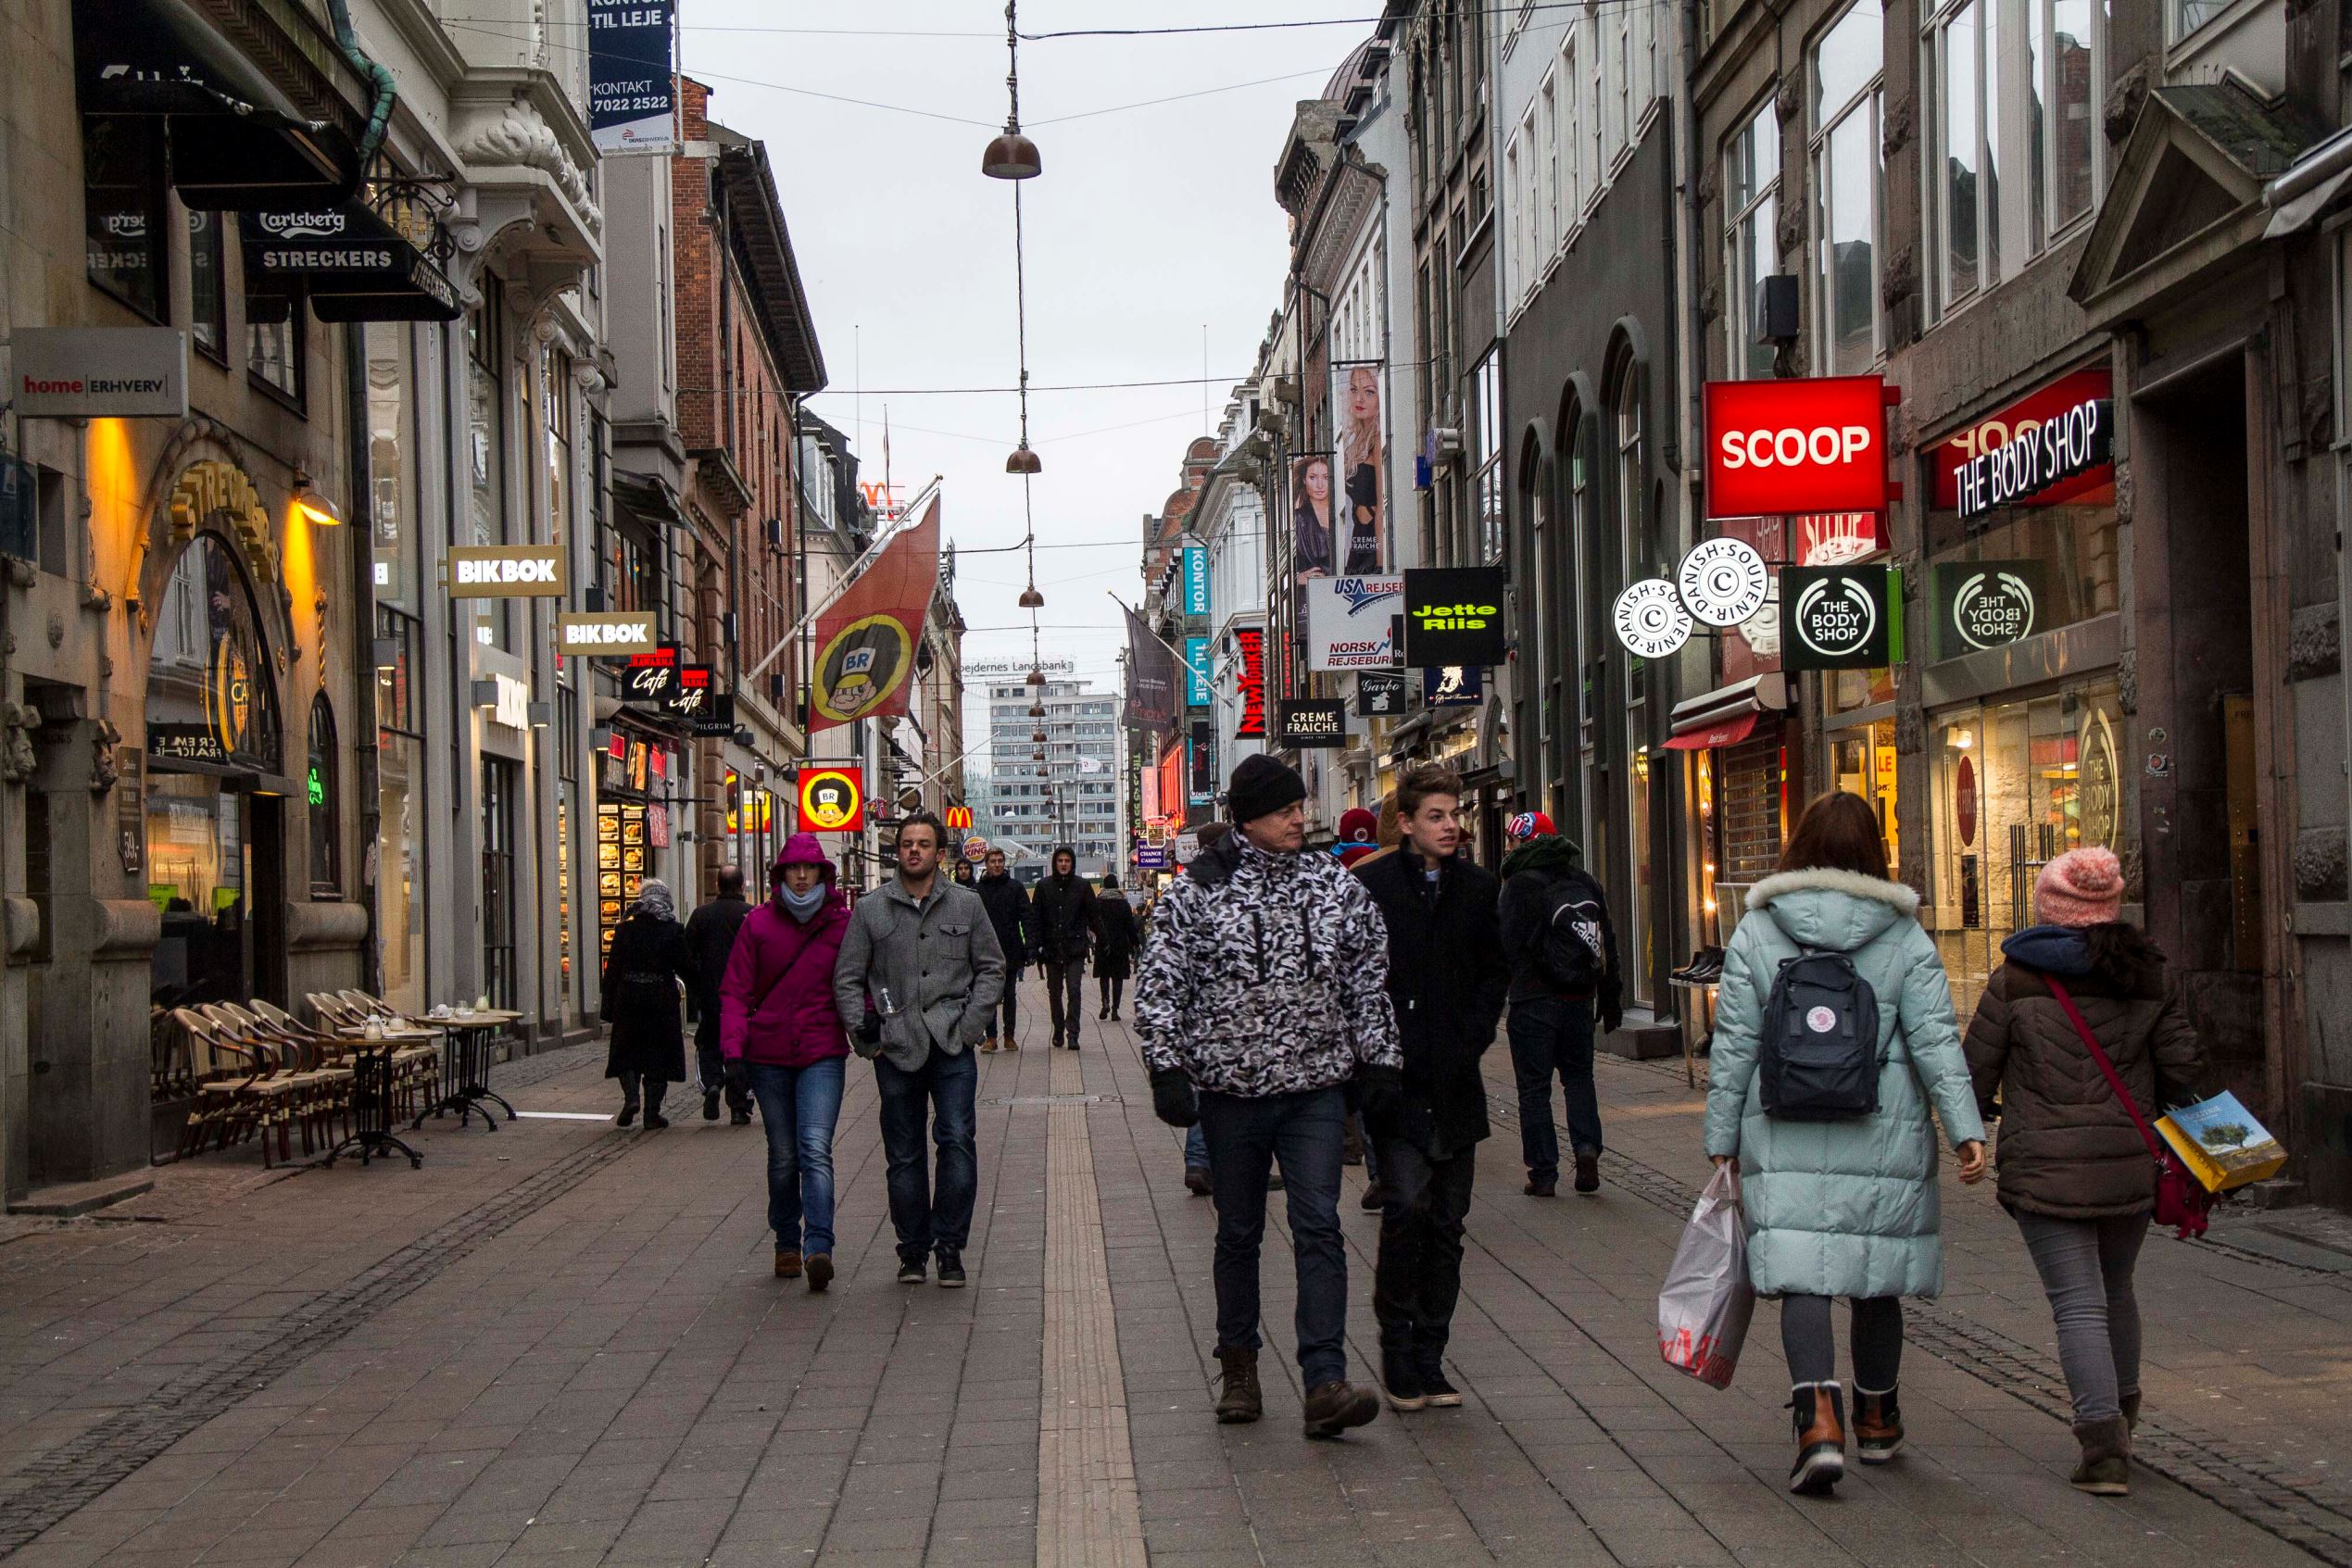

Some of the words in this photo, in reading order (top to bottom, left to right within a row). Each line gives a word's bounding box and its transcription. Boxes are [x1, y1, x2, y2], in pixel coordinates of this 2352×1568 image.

[591, 13, 618, 29] TIL
[622, 9, 662, 27] LEJE
[593, 81, 652, 94] KONTAKT
[595, 98, 630, 112] 7022
[633, 96, 668, 110] 2522
[259, 208, 346, 238] Carlsberg
[263, 251, 392, 268] STRECKERS
[24, 375, 83, 395] home
[91, 378, 163, 394] ERHVERV
[1720, 425, 1871, 469] SCOOP
[1954, 455, 1986, 519] THE
[1992, 426, 2042, 503] BODY
[2044, 399, 2096, 479] SHOP
[1192, 550, 1205, 613] KONTOR
[1684, 544, 1719, 613] DANISH
[1717, 544, 1763, 621] SOUVENIR
[1412, 604, 1497, 617] Jette
[1618, 584, 1650, 646] DANISH
[1821, 601, 1849, 612] THE
[1424, 618, 1486, 631] Riis
[1812, 613, 1861, 628] BODY
[1815, 628, 1858, 641] SHOP
[1195, 644, 1207, 666] TIL
[1330, 642, 1377, 653] NORSK
[845, 652, 869, 670] BR
[633, 668, 669, 696] Café
[1362, 679, 1401, 693] Garbo
[1291, 712, 1334, 722] CREME
[1287, 722, 1339, 733] FRAICHE
[2088, 758, 2104, 781] THE
[823, 792, 835, 801] BR
[2085, 784, 2111, 810] BODY
[964, 847, 987, 857] KING
[1572, 921, 1601, 958] adidas
